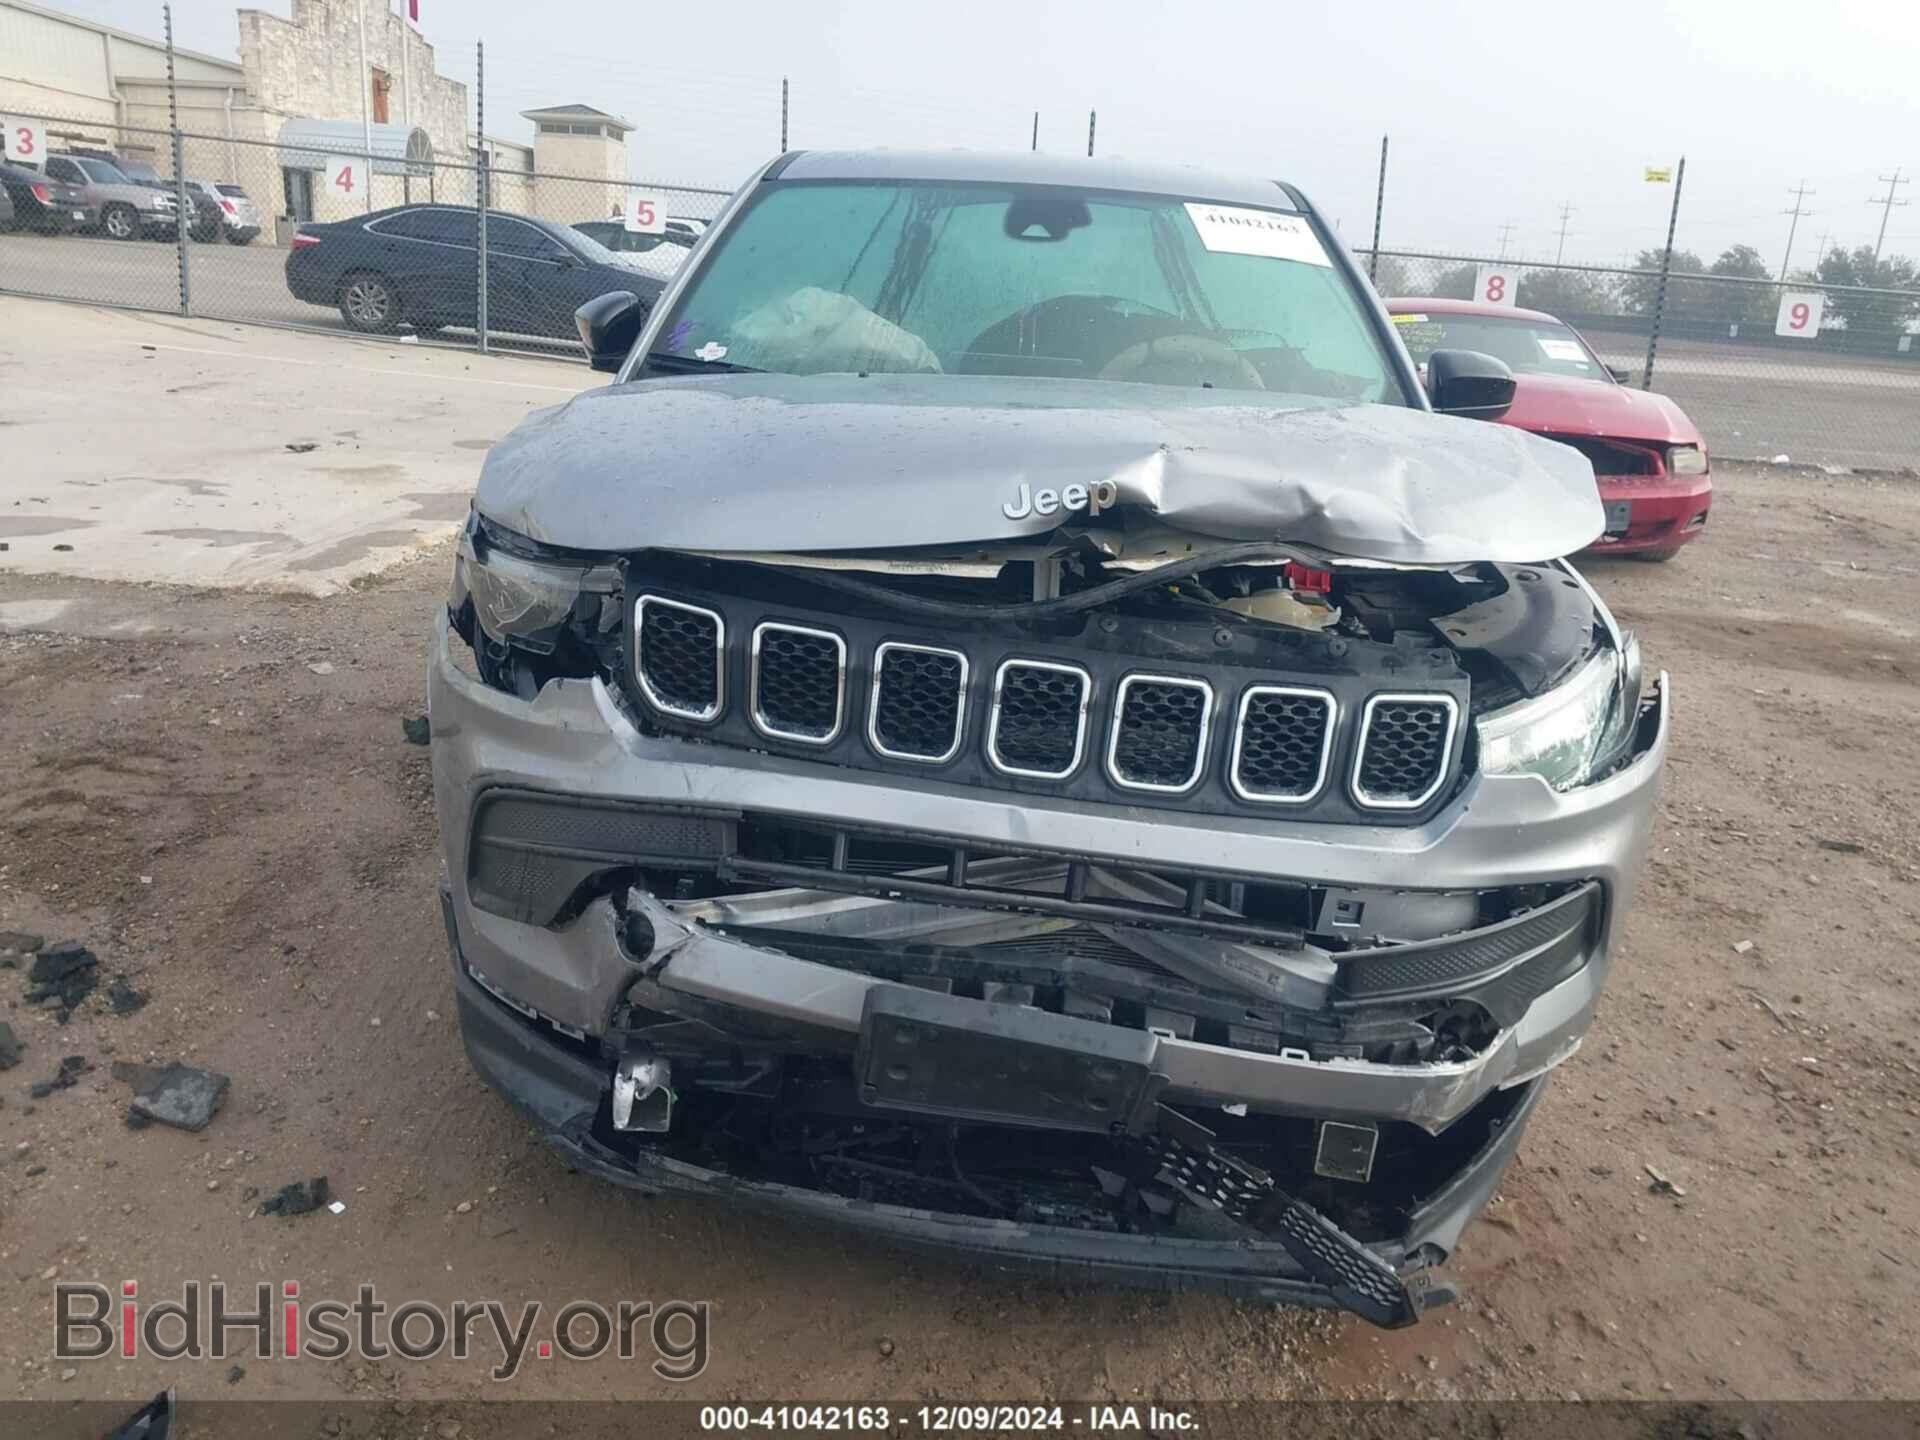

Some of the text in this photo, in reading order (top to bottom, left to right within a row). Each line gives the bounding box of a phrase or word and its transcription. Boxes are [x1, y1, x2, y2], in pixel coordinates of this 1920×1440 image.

[16, 127, 33, 154] 3
[335, 166, 354, 192] 4
[637, 200, 655, 226] 5
[1487, 275, 1505, 302] 8
[1790, 303, 1810, 330] 9
[1002, 479, 1118, 521] Jeep
